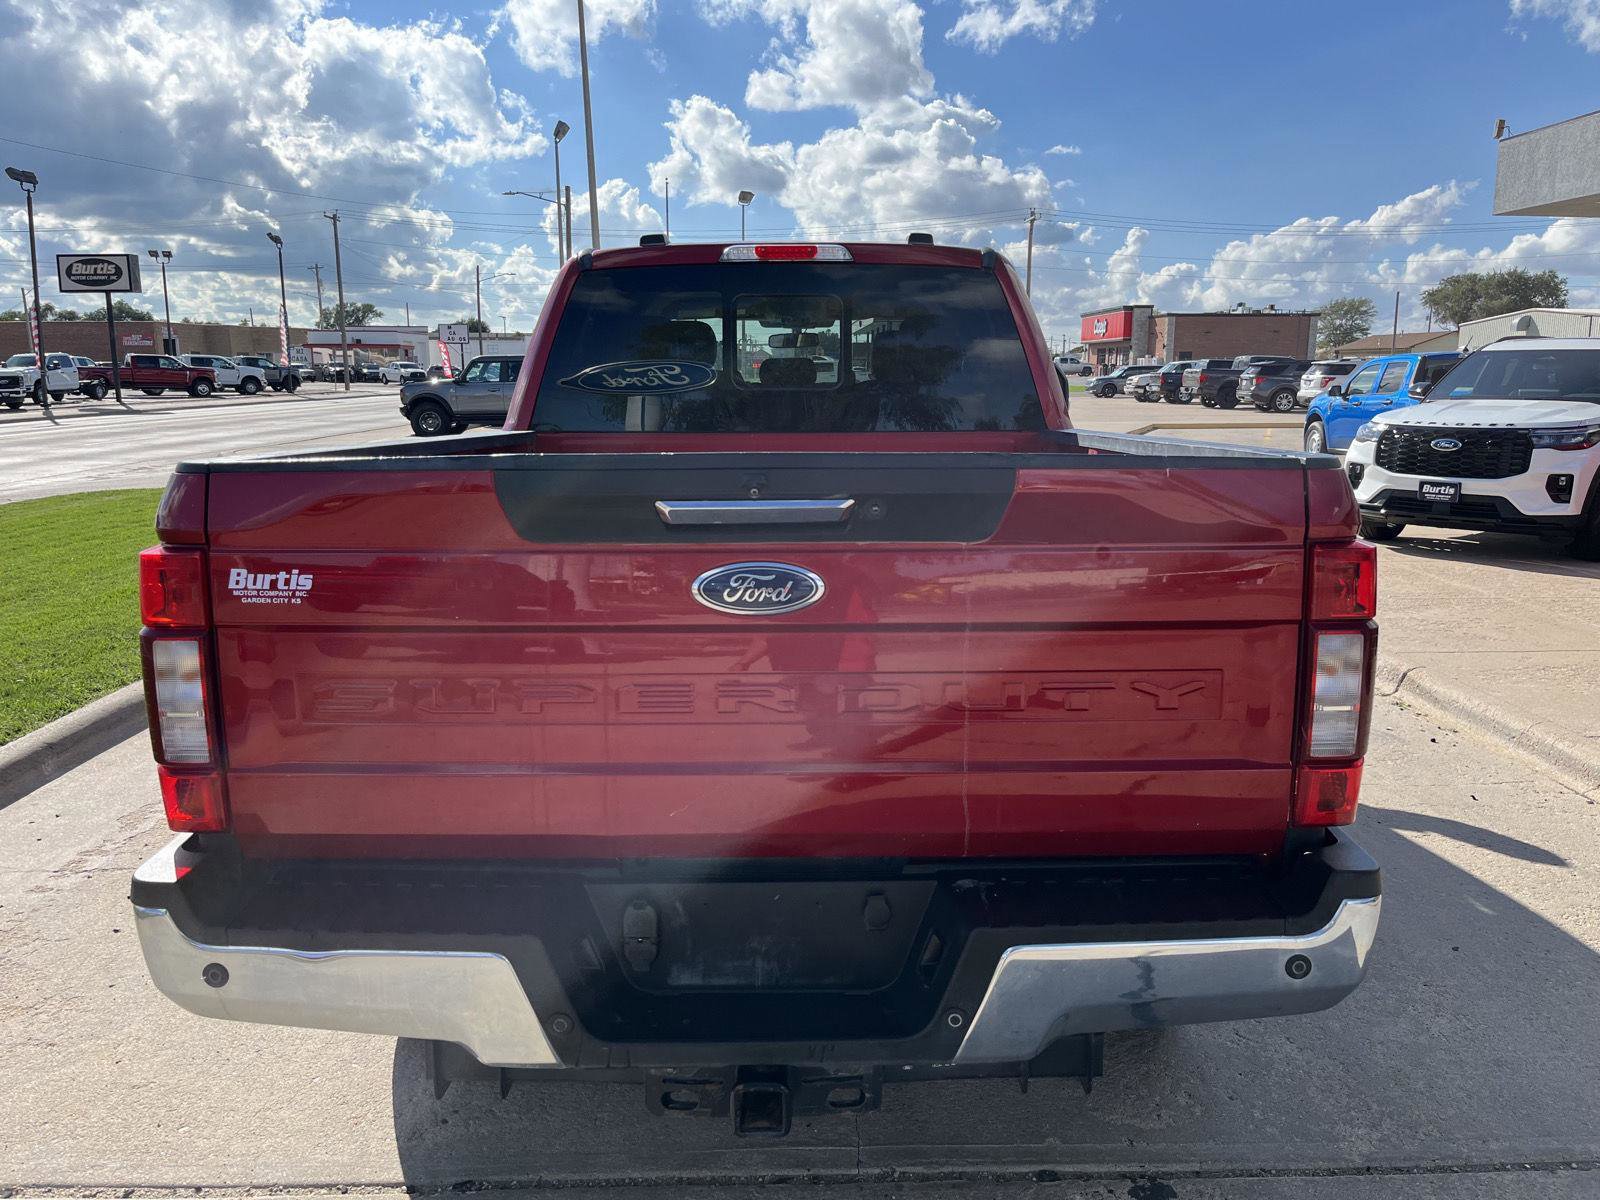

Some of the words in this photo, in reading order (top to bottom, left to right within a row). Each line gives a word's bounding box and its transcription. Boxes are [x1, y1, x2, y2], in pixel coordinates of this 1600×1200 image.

[71, 262, 116, 275] Burtis
[1422, 484, 1456, 495] Burtis
[228, 568, 313, 590] Burtis
[723, 573, 793, 603] Ford
[313, 677, 797, 714] SUPER
[837, 681, 1207, 714] DUTY
